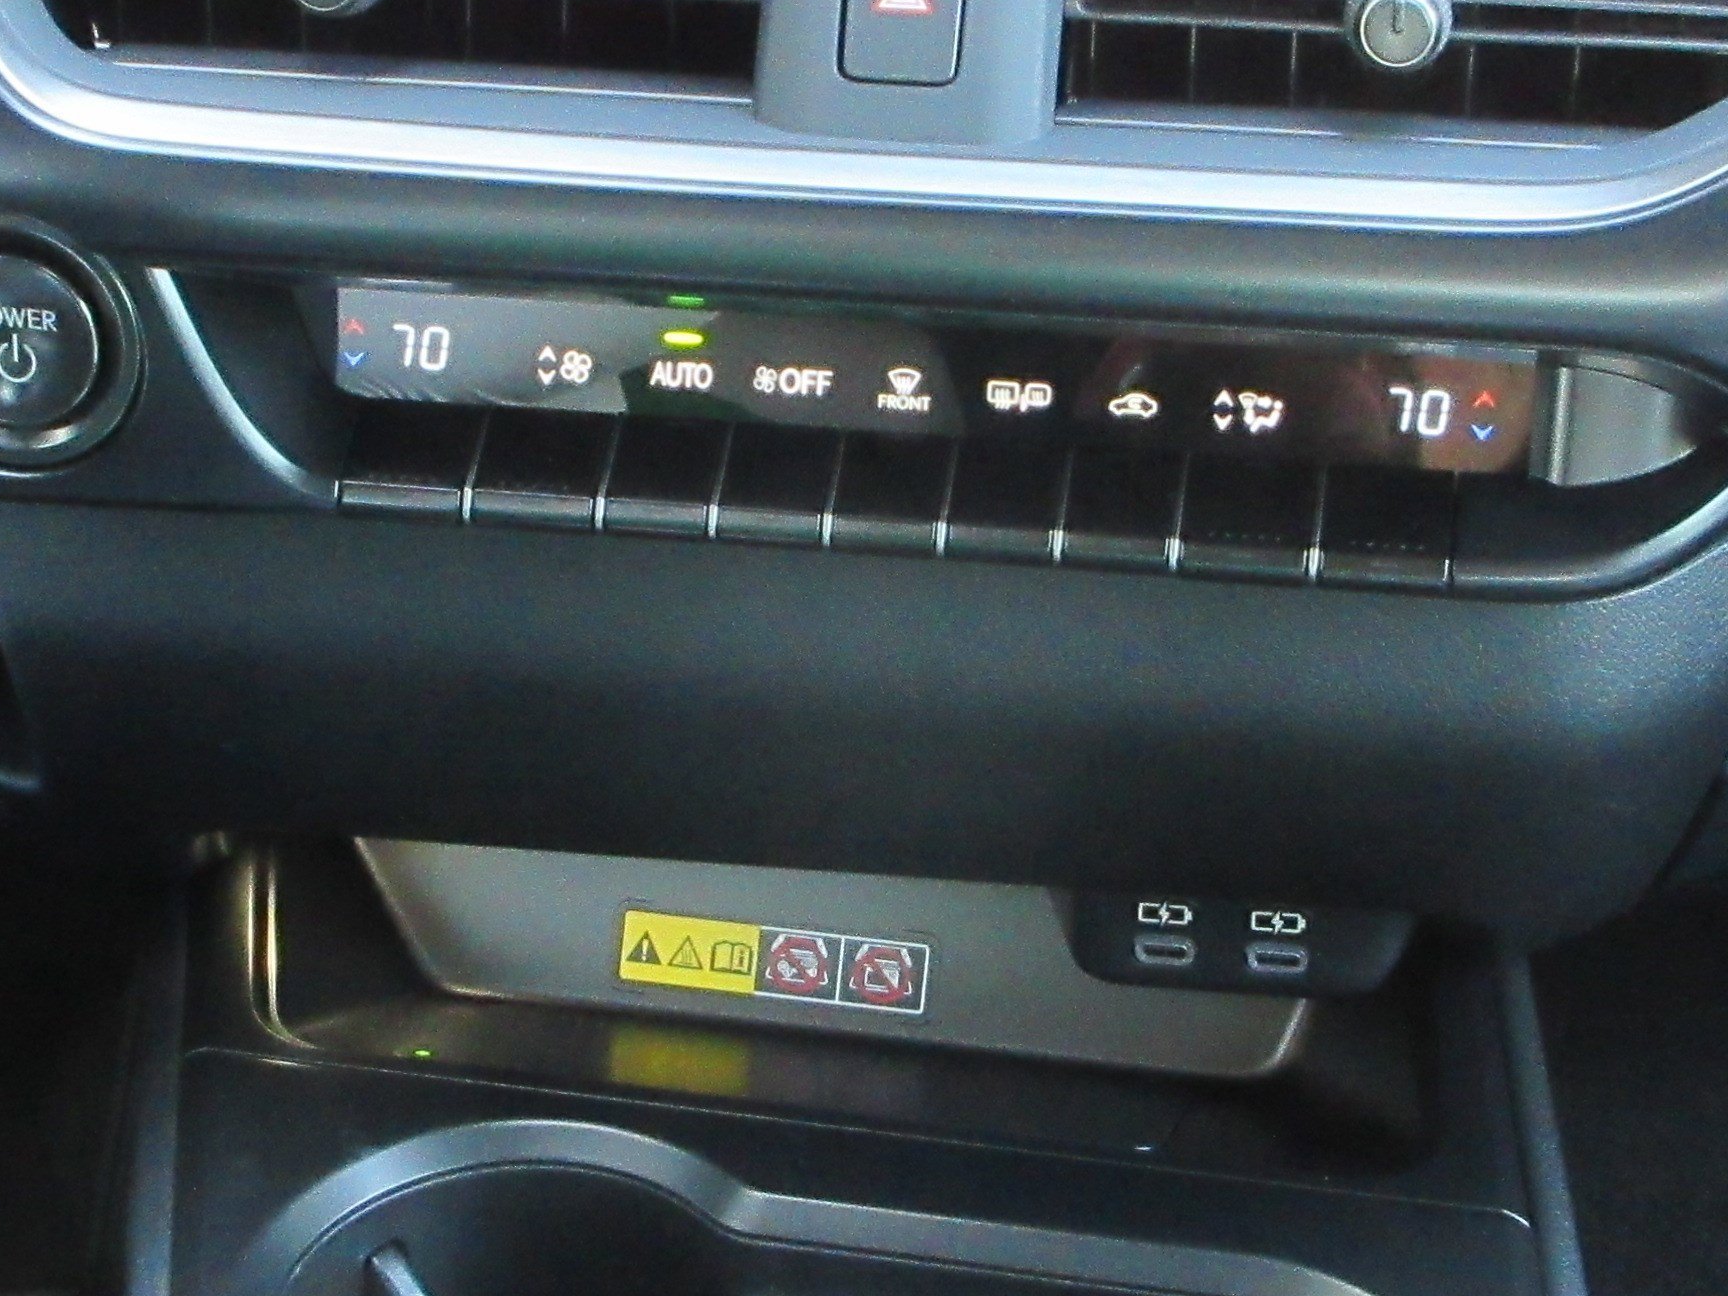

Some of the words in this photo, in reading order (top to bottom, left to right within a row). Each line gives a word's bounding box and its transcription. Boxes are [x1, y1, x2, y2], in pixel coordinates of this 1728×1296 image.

[391, 323, 452, 373] 70
[649, 360, 714, 391] AUTO
[778, 367, 835, 397] OFF
[876, 392, 932, 413] FRONT
[1387, 385, 1452, 437] 70
